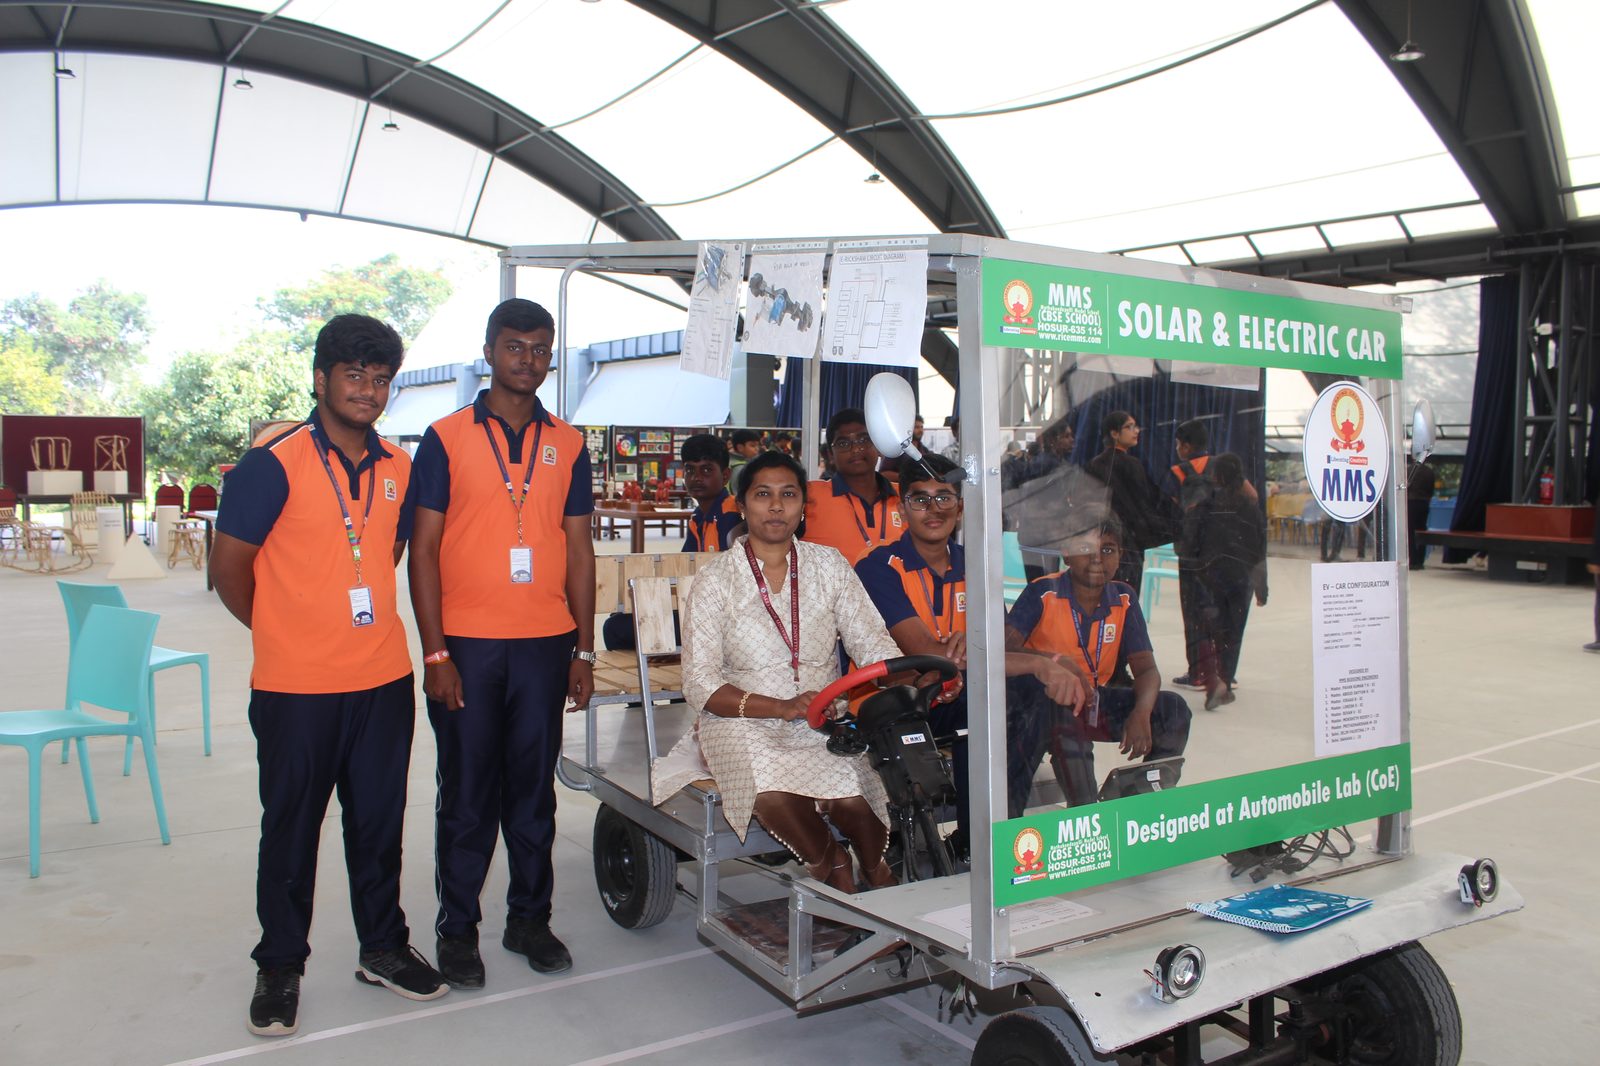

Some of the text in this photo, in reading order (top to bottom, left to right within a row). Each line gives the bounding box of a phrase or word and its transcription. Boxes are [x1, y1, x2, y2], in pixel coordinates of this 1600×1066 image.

[1048, 282, 1092, 310] MMS
[1037, 322, 1103, 336] HOSUR-635 114
[1038, 309, 1102, 327] (CBSE SCHOOL)
[1038, 332, 1102, 344] www.ricemms.com
[1118, 300, 1386, 362] SOLAR & ELECTRIC CAR
[1322, 468, 1376, 503] MMS
[1335, 582, 1346, 590] CAR
[1347, 580, 1390, 590] CONFIGURATION
[1126, 764, 1400, 846] Designed at Automobile Lab (CoE)
[1058, 813, 1101, 843] MMS
[1047, 850, 1112, 872] HOSUR-635 114
[1048, 838, 1111, 864] (CBSE SCHOOL)
[1048, 860, 1111, 880] www.ricemms.com
